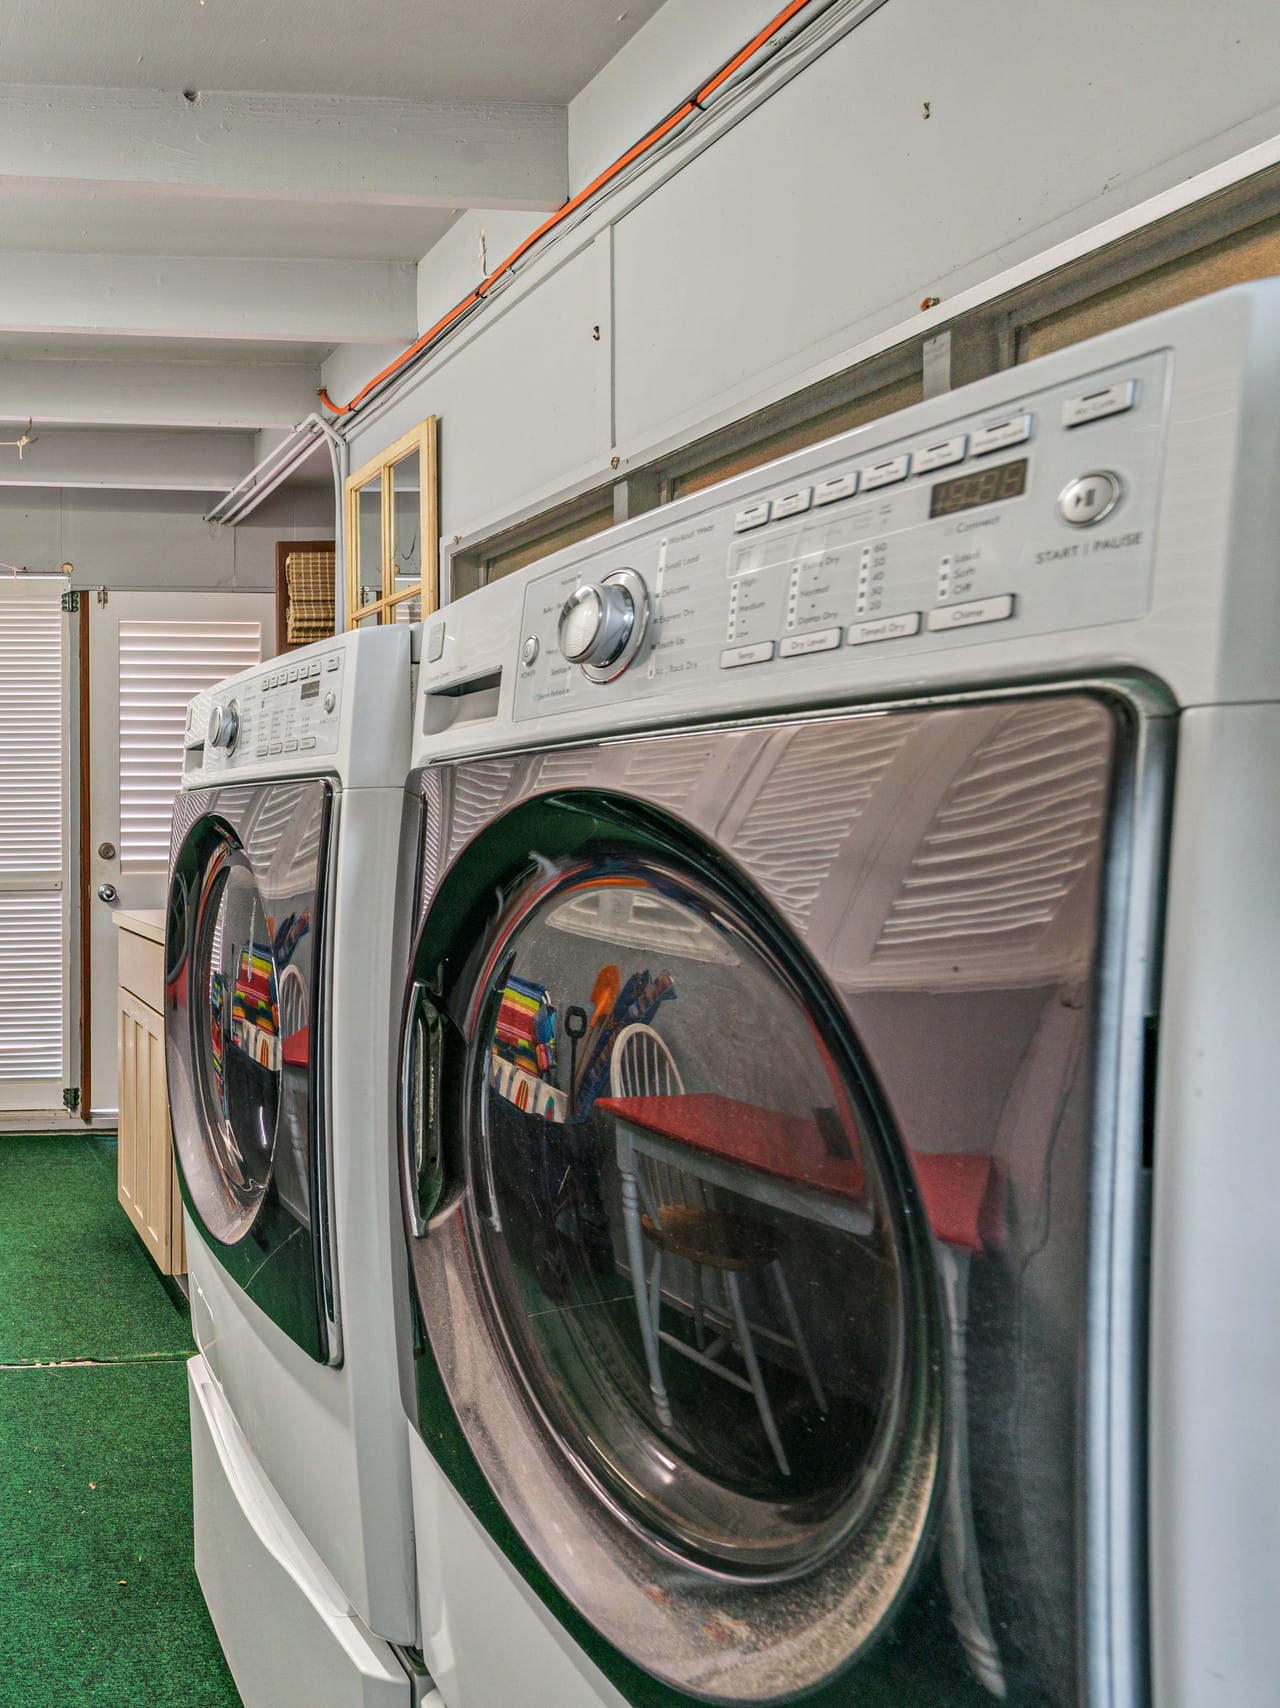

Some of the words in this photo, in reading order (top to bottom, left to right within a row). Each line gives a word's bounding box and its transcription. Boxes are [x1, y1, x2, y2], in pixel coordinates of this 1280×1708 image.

[955, 515, 1001, 534] Connect
[1035, 545, 1079, 564] START
[1092, 531, 1144, 552] PAUSE
[887, 622, 906, 634] Dry
